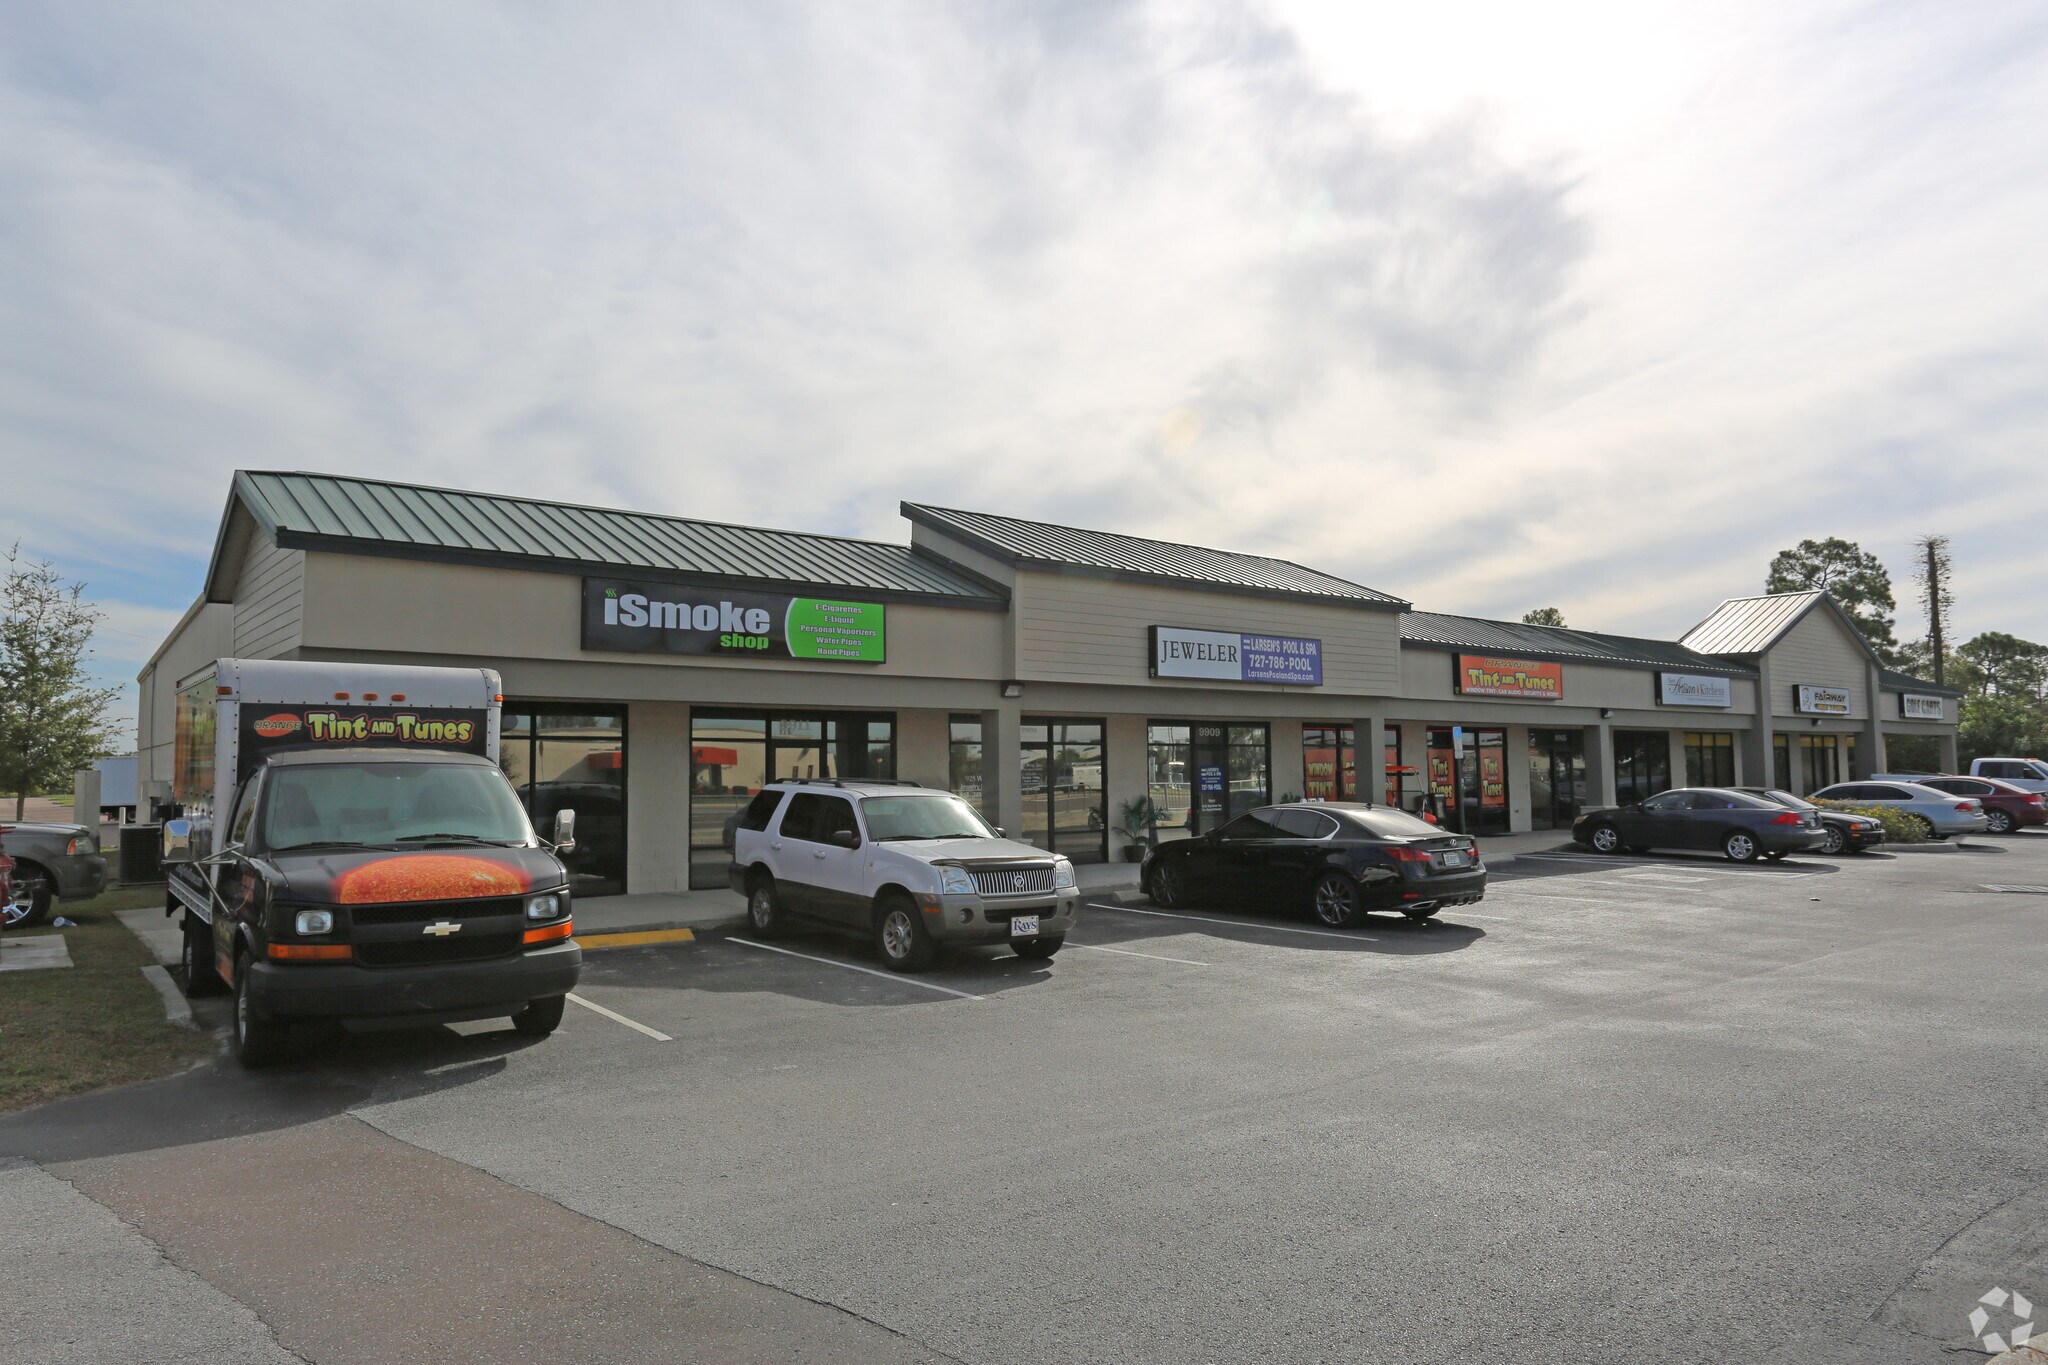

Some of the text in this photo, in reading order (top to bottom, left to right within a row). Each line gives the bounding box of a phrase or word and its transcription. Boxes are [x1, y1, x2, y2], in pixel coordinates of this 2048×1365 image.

[604, 589, 770, 634] iSmoke
[815, 603, 862, 614] E-Cigarettes
[824, 615, 854, 624] E-Liquid
[800, 625, 877, 637] Personal Vaporizers
[720, 634, 769, 650] shop
[816, 636, 862, 647] Water Pipes
[1251, 638, 1317, 656] LARSEN'S POOL & SPA
[817, 647, 861, 657] Hand Pipes
[1161, 640, 1238, 663] JEWELER
[1249, 654, 1312, 671] 727-786-POOL
[1484, 658, 1540, 671] ORANGE
[1467, 668, 1555, 690] Tint AND Tunes
[254, 719, 302, 731] ORANGE
[307, 712, 473, 741] Tint AND Tunes
[1199, 727, 1220, 736] 9909
[1432, 758, 1448, 776] Tint
[1484, 758, 1498, 775] Tint
[1308, 781, 1334, 797] TINT
[1431, 781, 1453, 798] Tunes
[1483, 780, 1502, 796] Tunes
